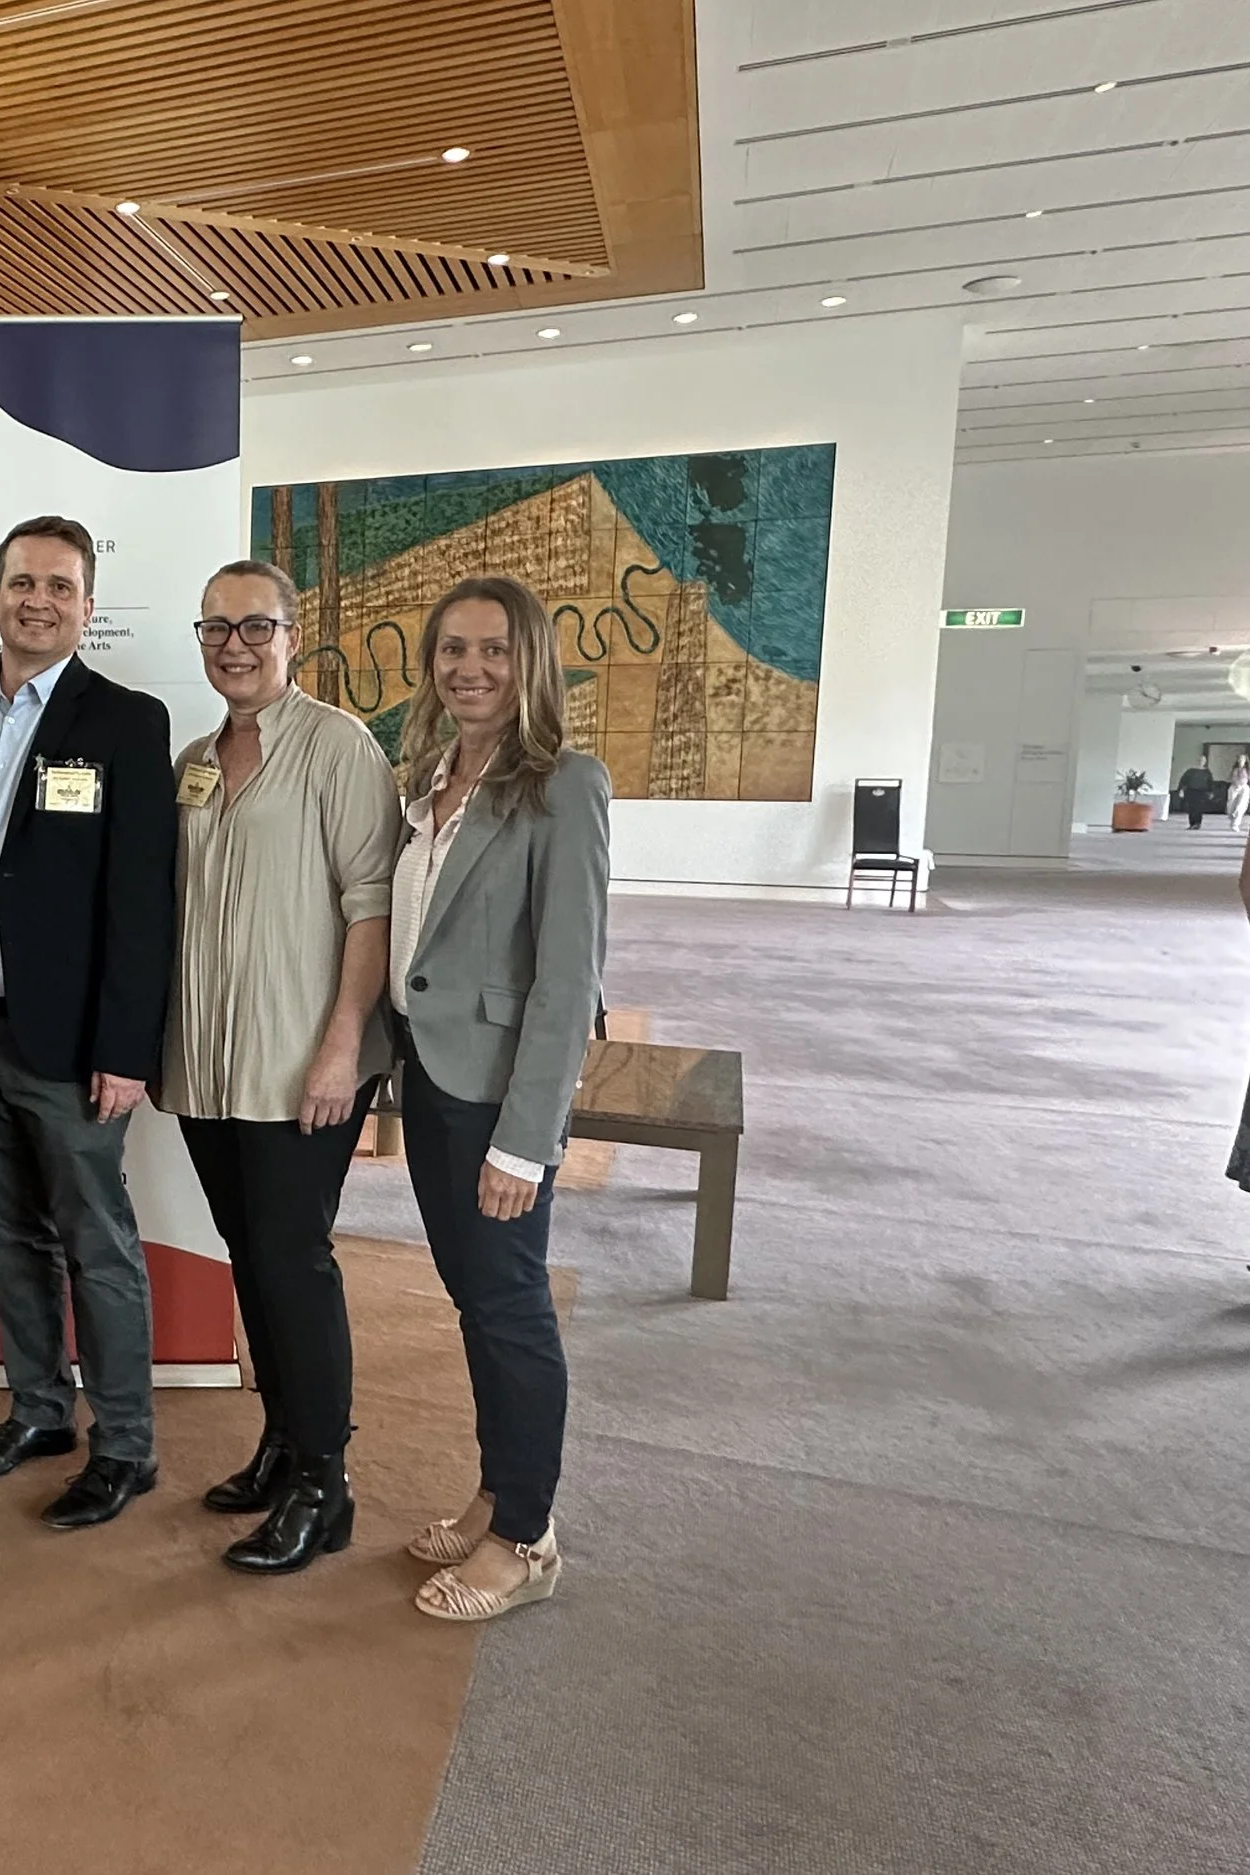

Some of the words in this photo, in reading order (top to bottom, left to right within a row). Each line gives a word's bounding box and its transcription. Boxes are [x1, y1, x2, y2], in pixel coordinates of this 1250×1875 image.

[965, 611, 1001, 625] EXIT
[83, 627, 134, 639] elopment,
[90, 641, 111, 650] Arts
